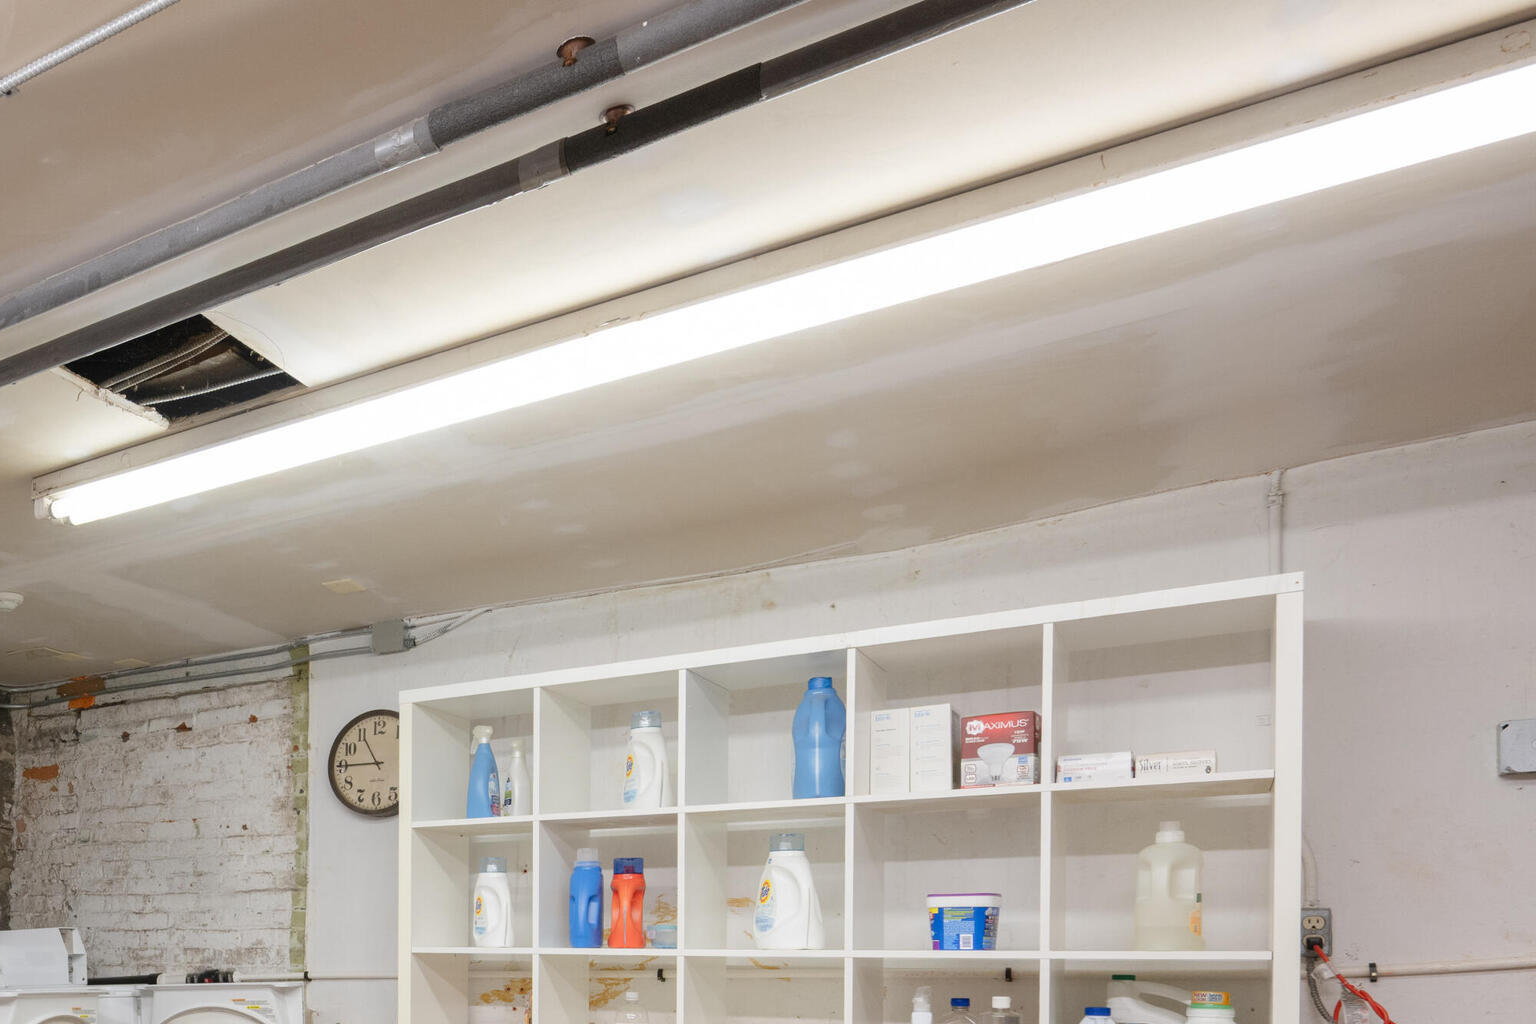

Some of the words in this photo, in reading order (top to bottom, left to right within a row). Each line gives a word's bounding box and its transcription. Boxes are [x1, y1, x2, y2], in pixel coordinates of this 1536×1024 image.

[373, 720, 386, 735] 12
[966, 718, 1028, 735] MAXIMUS
[358, 727, 366, 742] 11
[345, 742, 357, 756] 10
[339, 759, 348, 773] 9
[344, 775, 353, 790] 8
[357, 788, 365, 803] 7
[371, 791, 381, 807] 6
[388, 786, 398, 801] 5
